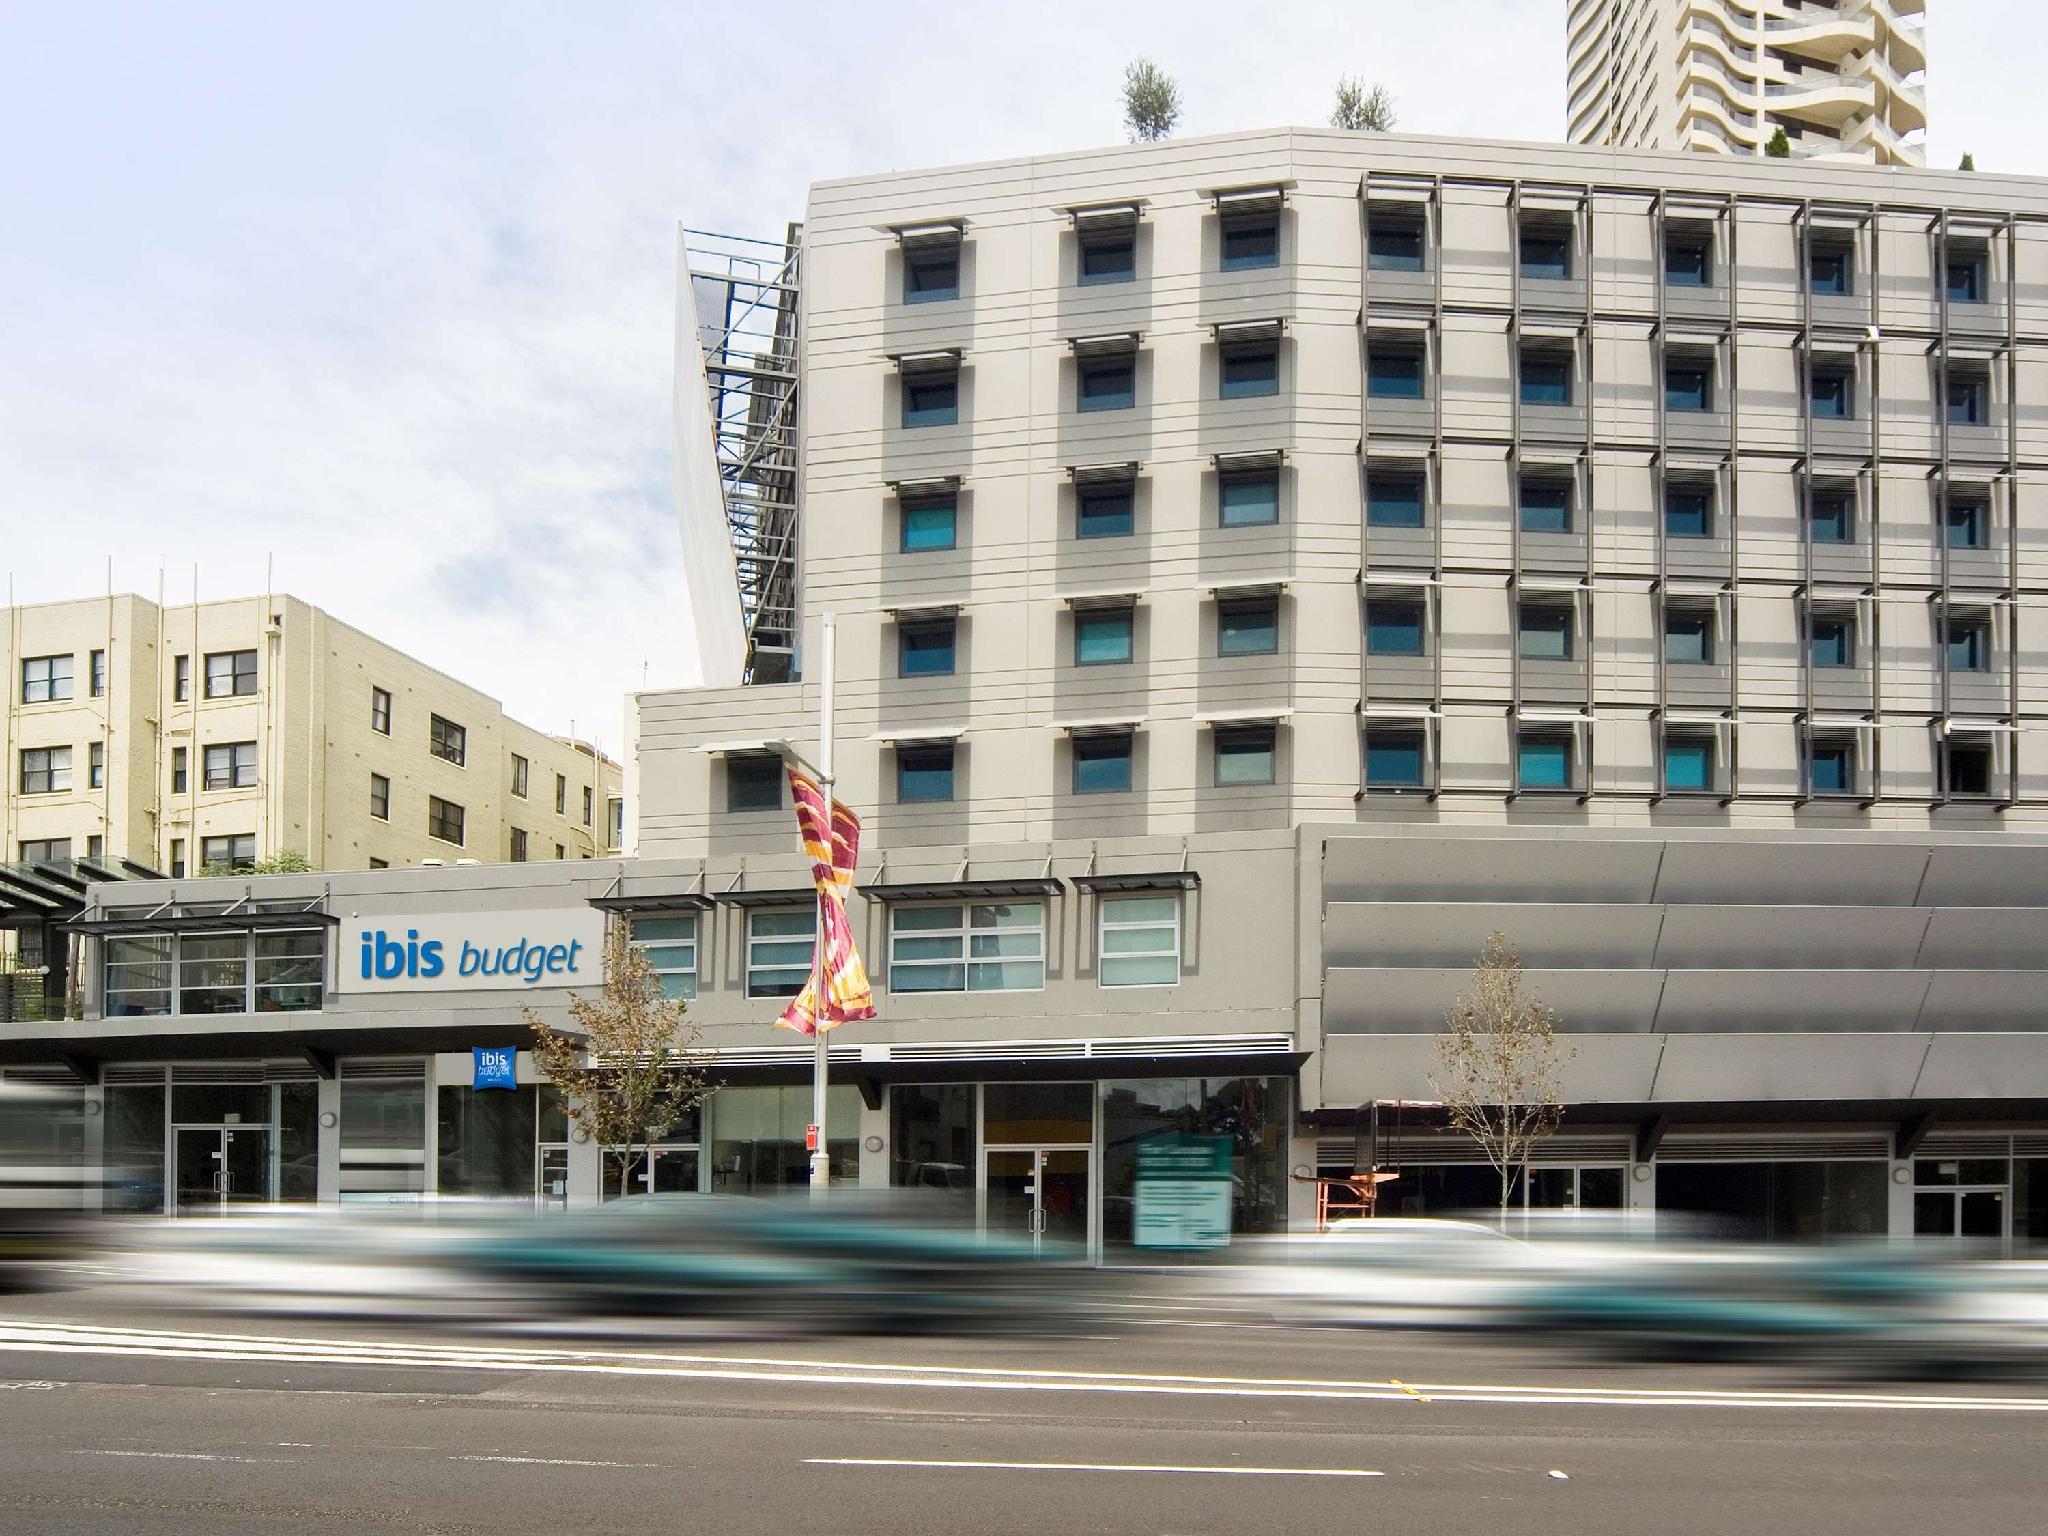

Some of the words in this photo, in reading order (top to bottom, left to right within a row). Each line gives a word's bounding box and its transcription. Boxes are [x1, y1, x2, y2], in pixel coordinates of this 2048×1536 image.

[361, 929, 444, 979] ibis
[458, 937, 582, 982] budget
[481, 1052, 507, 1066] ibis
[478, 1066, 510, 1078] budget
